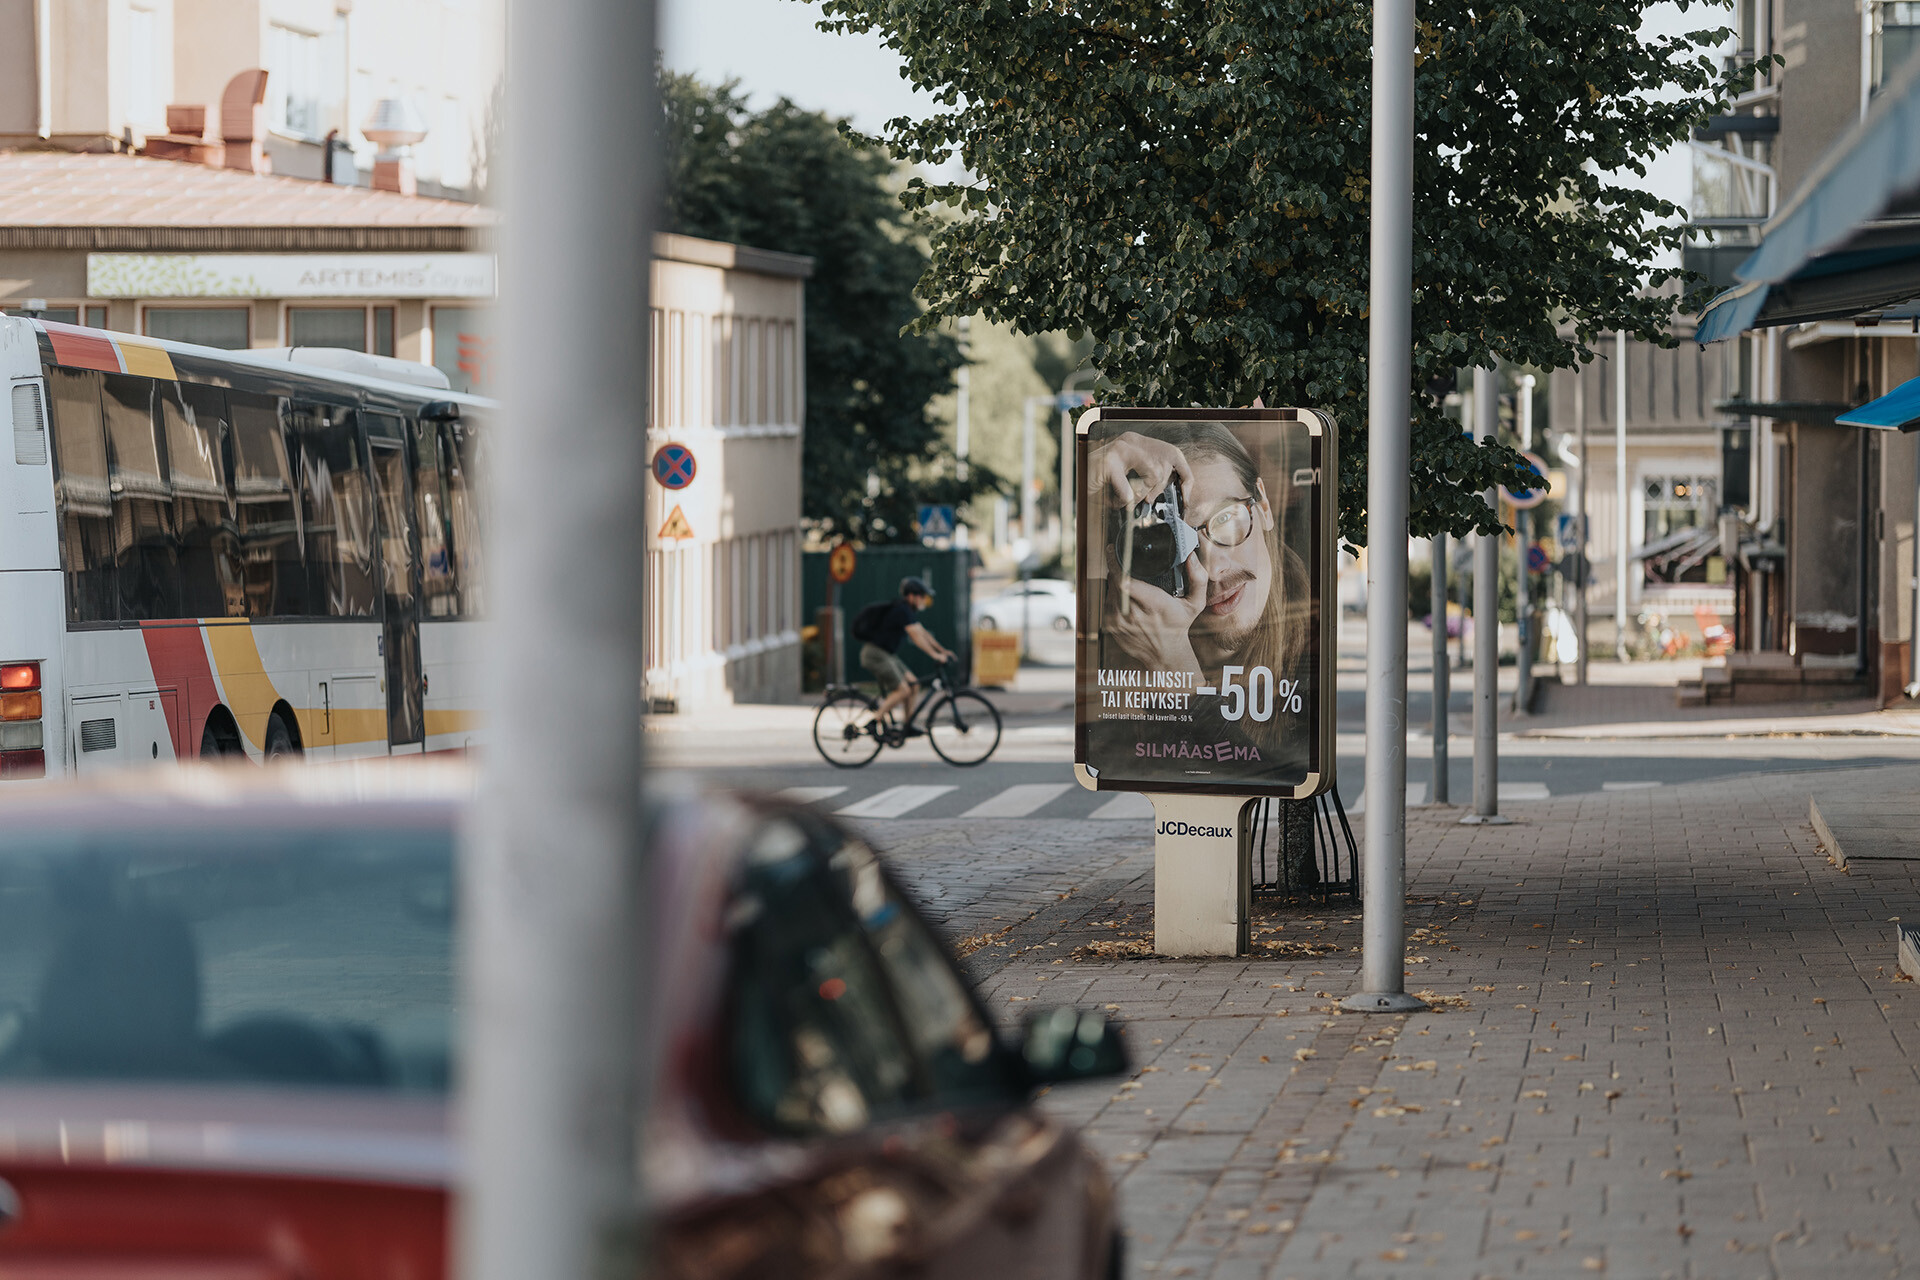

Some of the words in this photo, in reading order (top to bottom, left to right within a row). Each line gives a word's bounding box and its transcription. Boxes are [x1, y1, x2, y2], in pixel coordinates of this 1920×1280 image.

[299, 268, 426, 288] ARTEMIS
[1097, 669, 1141, 687] KAIKKI
[1145, 670, 1195, 689] LINSSIT
[1100, 690, 1120, 708] TAI
[1125, 691, 1190, 710] KEHYKSET
[1196, 665, 1302, 722] -50%
[1102, 712, 1118, 720] toiset
[1118, 712, 1130, 720] lasit
[1130, 713, 1146, 721] itselle
[1146, 713, 1155, 721] tai
[1155, 713, 1177, 722] kaverille
[1135, 741, 1262, 762] SILMÄASEMA
[1157, 821, 1233, 838] JCDecaux
